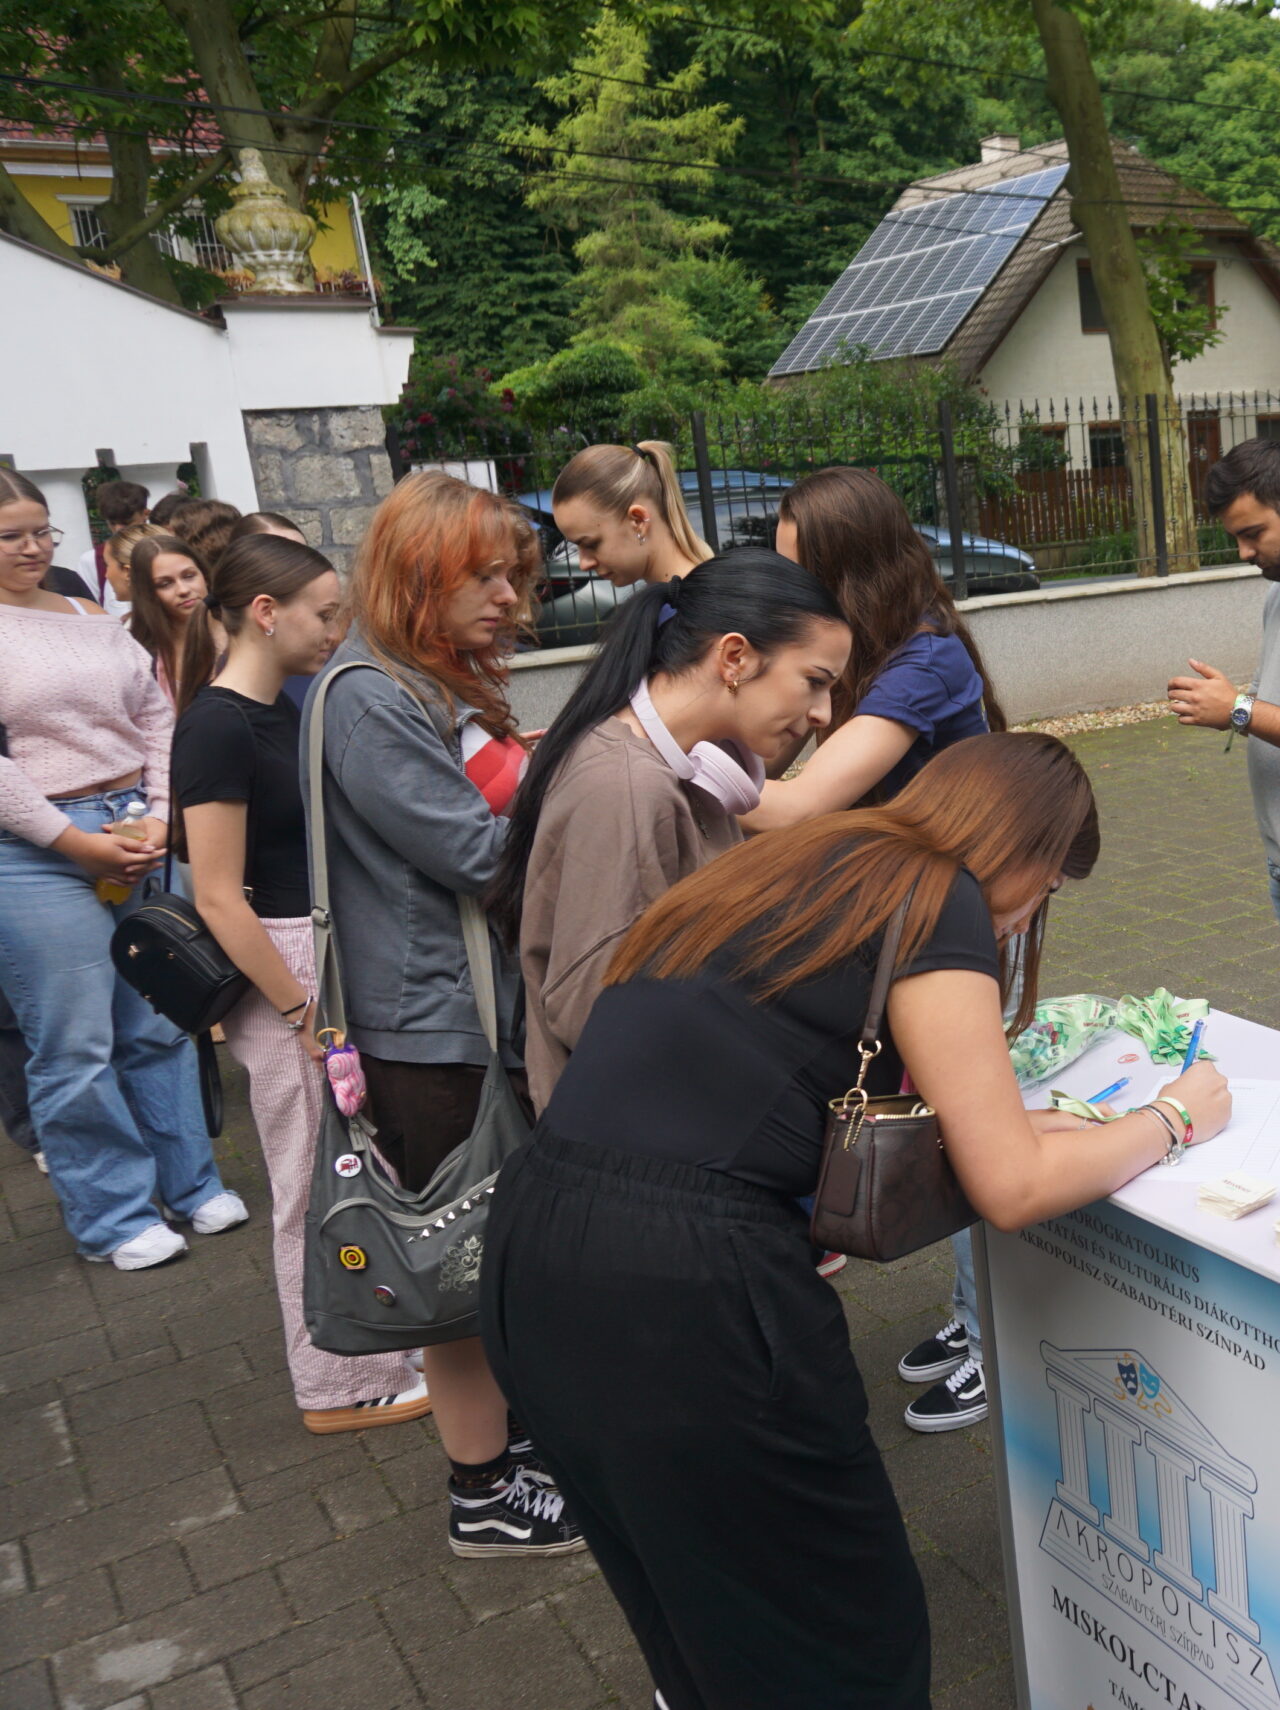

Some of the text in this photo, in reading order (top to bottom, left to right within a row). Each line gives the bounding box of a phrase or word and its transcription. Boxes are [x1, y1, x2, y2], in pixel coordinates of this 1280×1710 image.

[1018, 1229, 1266, 1371] AKROPOLISZ SZABADTÉRI SZÍNPAD
[1108, 1250, 1192, 1305] KULTURÁLIS
[1056, 1509, 1264, 1686] AKROPOLISZ
